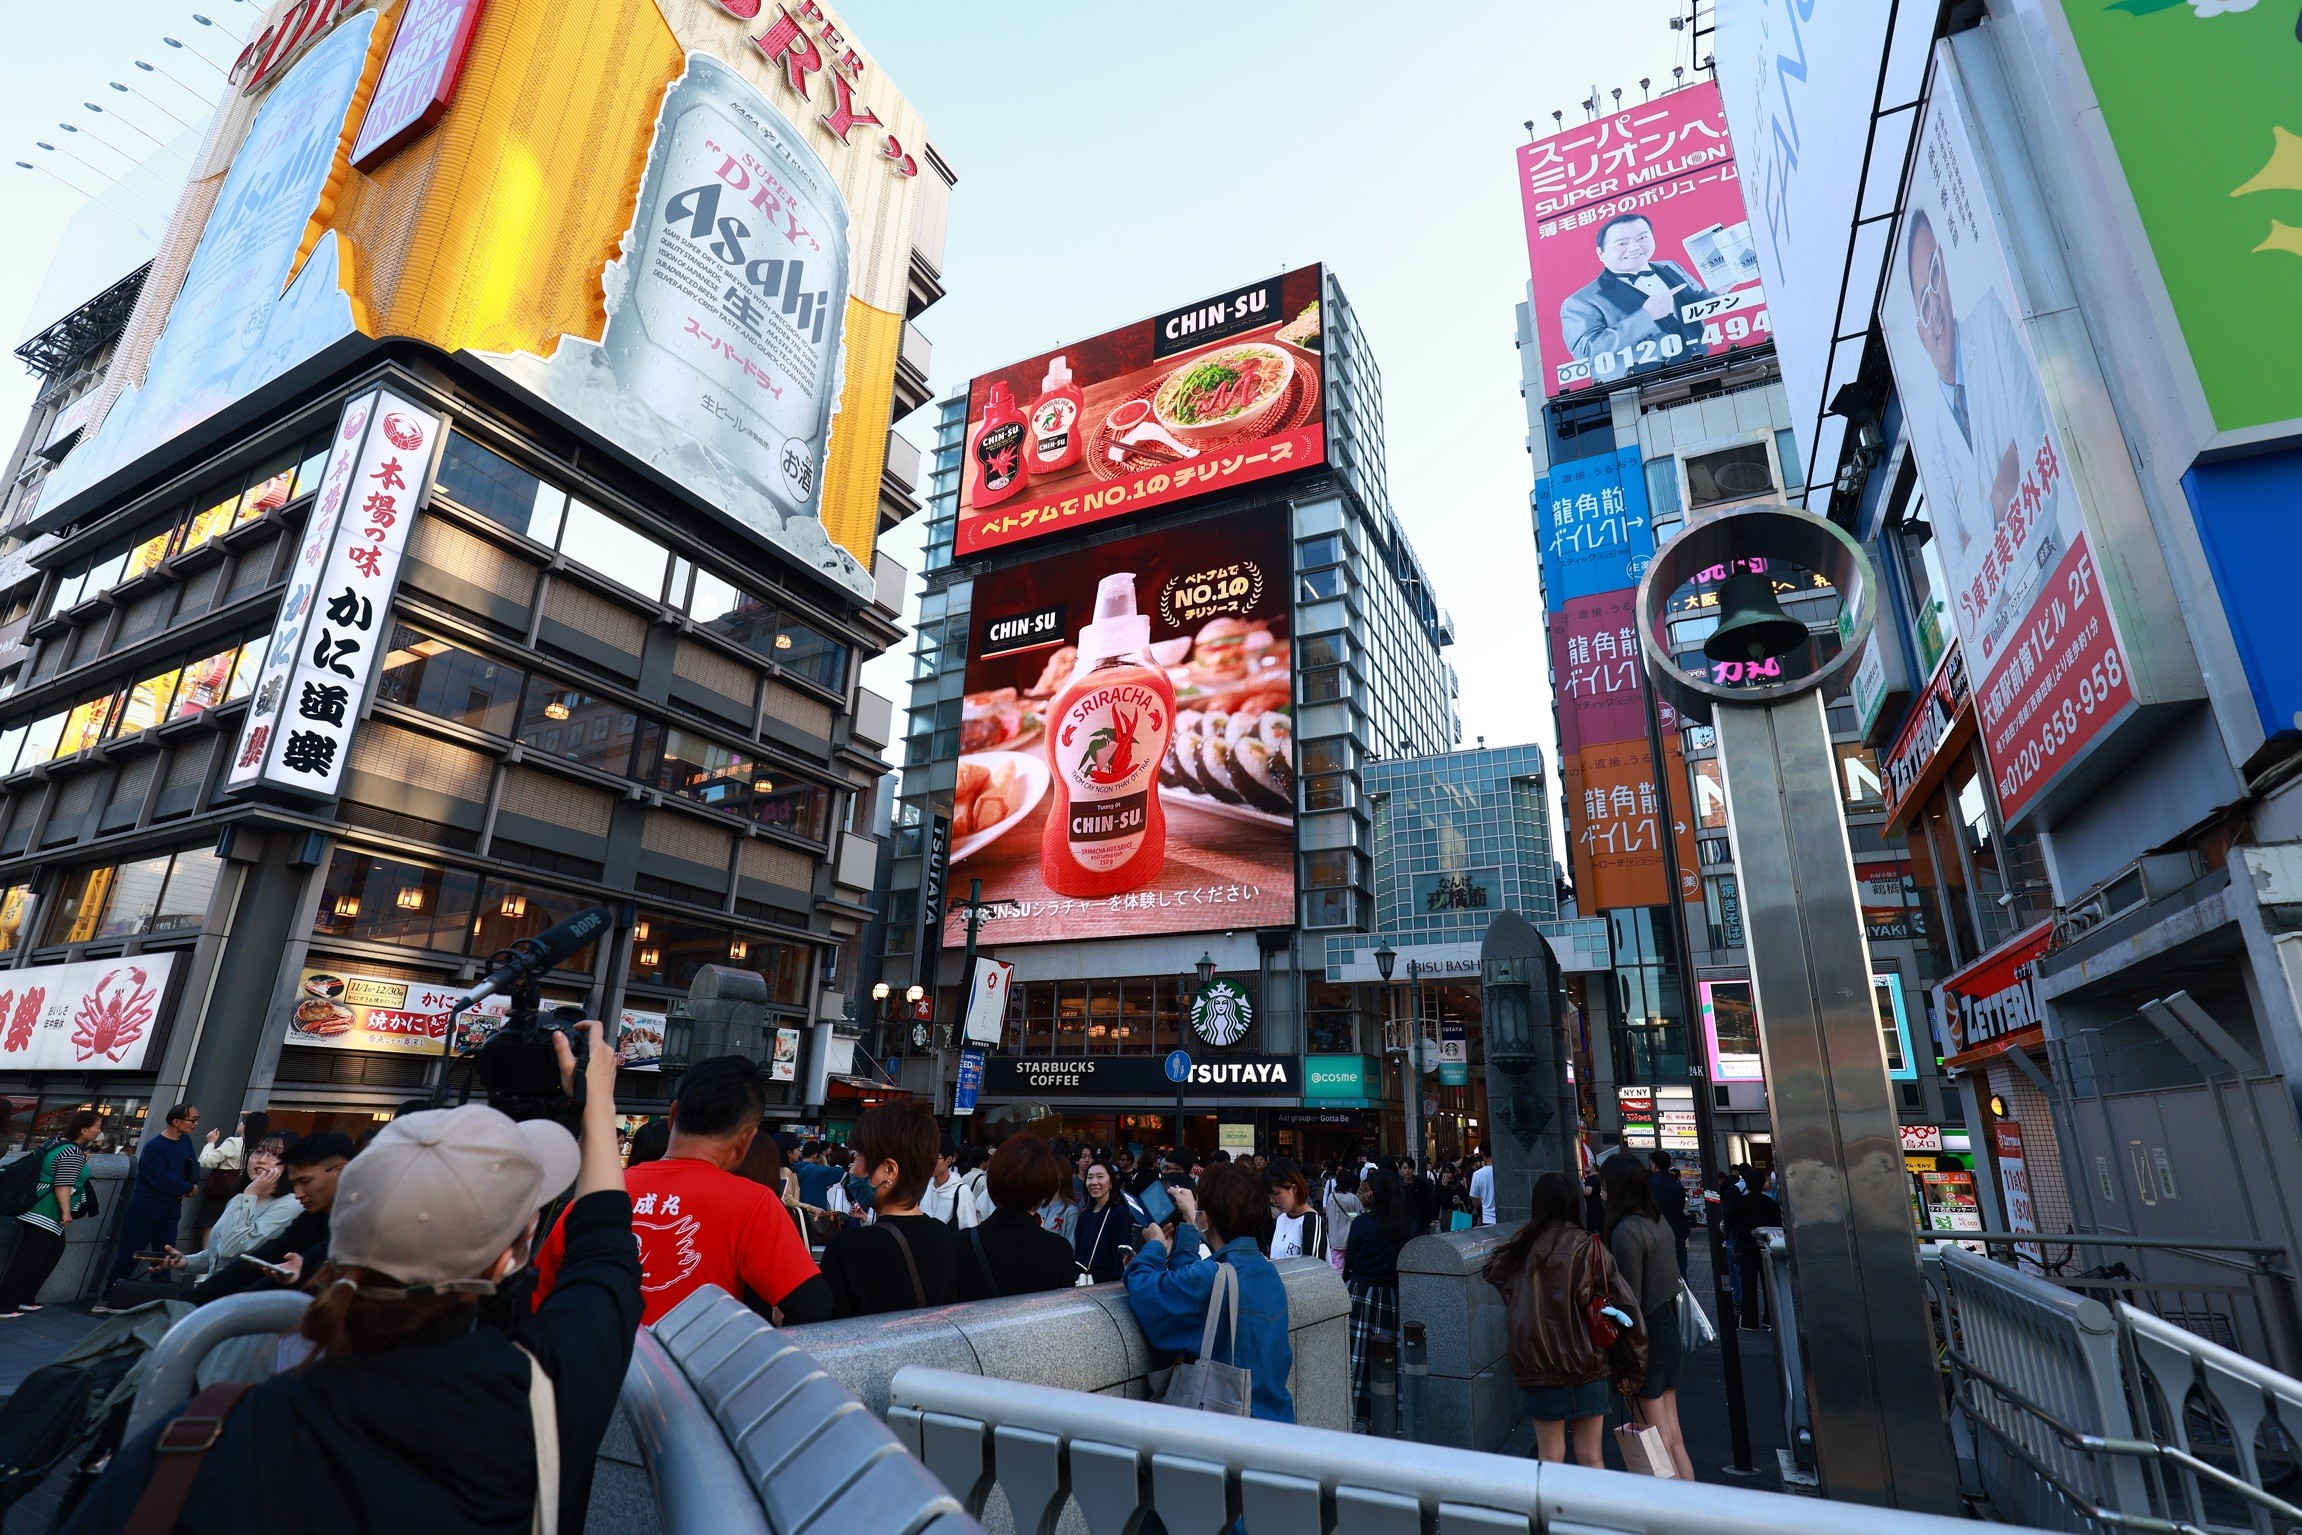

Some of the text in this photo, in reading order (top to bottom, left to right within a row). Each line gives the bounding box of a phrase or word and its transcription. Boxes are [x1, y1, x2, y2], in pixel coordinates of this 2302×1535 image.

[380, 6, 462, 95] 1889
[359, 60, 442, 146] OSAKA
[1528, 110, 1669, 173] スーパー
[742, 153, 798, 212] SUPER
[1534, 143, 1727, 217] SUPER MILLION
[665, 183, 829, 345] Asahi
[658, 247, 679, 263] VISION
[677, 258, 687, 269] OF
[685, 264, 720, 292] JAPANESE
[766, 328, 794, 356] MASTER
[660, 237, 685, 257] QUALITY
[684, 251, 722, 283] STANDARDS,
[768, 318, 791, 341] UNDER
[790, 338, 803, 353] THE
[663, 227, 819, 361] ASAHI SUPER DRY IS BREWED WITH PRECISION TO HIGH
[722, 285, 764, 339] 生
[1165, 289, 1267, 340] CHIN-SU
[1689, 297, 1740, 320] ルアン
[653, 268, 677, 289] DELIVER
[697, 298, 719, 315] CRISP
[719, 312, 741, 333] TASTE
[740, 330, 758, 346] AND
[779, 363, 798, 383] CLEAN
[655, 257, 669, 271] OUR
[667, 264, 699, 289] ADVANCED
[764, 338, 780, 354] ING
[778, 350, 815, 389] TECHNIQUES
[1594, 309, 1774, 375] 0120-494
[684, 316, 784, 400] スーパードライ
[982, 425, 1020, 447] CHIN-SU
[1039, 438, 1066, 451] CHIN-SU
[783, 449, 813, 495] お酒
[348, 457, 407, 580] 本場の味
[1552, 486, 1628, 528] 龍角散
[1971, 434, 2060, 620] 東京美容外科
[1549, 516, 1636, 557] ダイレクト
[1175, 576, 1249, 609] NO.1の
[1185, 564, 1239, 584] ベトナムで
[989, 611, 1057, 642] CHIN-SU
[1185, 601, 1239, 621] チリソース
[1983, 554, 2092, 734] 大阪駅前第1ビル 2F
[1073, 686, 1153, 723] SRIRACHA
[2007, 647, 2123, 796] 0120-658-958
[1072, 808, 1141, 834] CHIN-SU
[925, 826, 946, 926] TSUTAYA
[569, 911, 602, 938] RØDE
[1720, 884, 1742, 940] 焼きそば
[367, 1011, 424, 1032] 焼かに
[917, 999, 929, 1016] 本
[1015, 1061, 1096, 1074] STARBUCKS
[1029, 1075, 1080, 1087] COFFEE
[1187, 1063, 1288, 1084] TSUTAYA
[1310, 1071, 1358, 1085] @cosme
[1623, 1088, 1648, 1097] NY NY
[1290, 1115, 1311, 1123] group
[1320, 1114, 1339, 1122] Gotta
